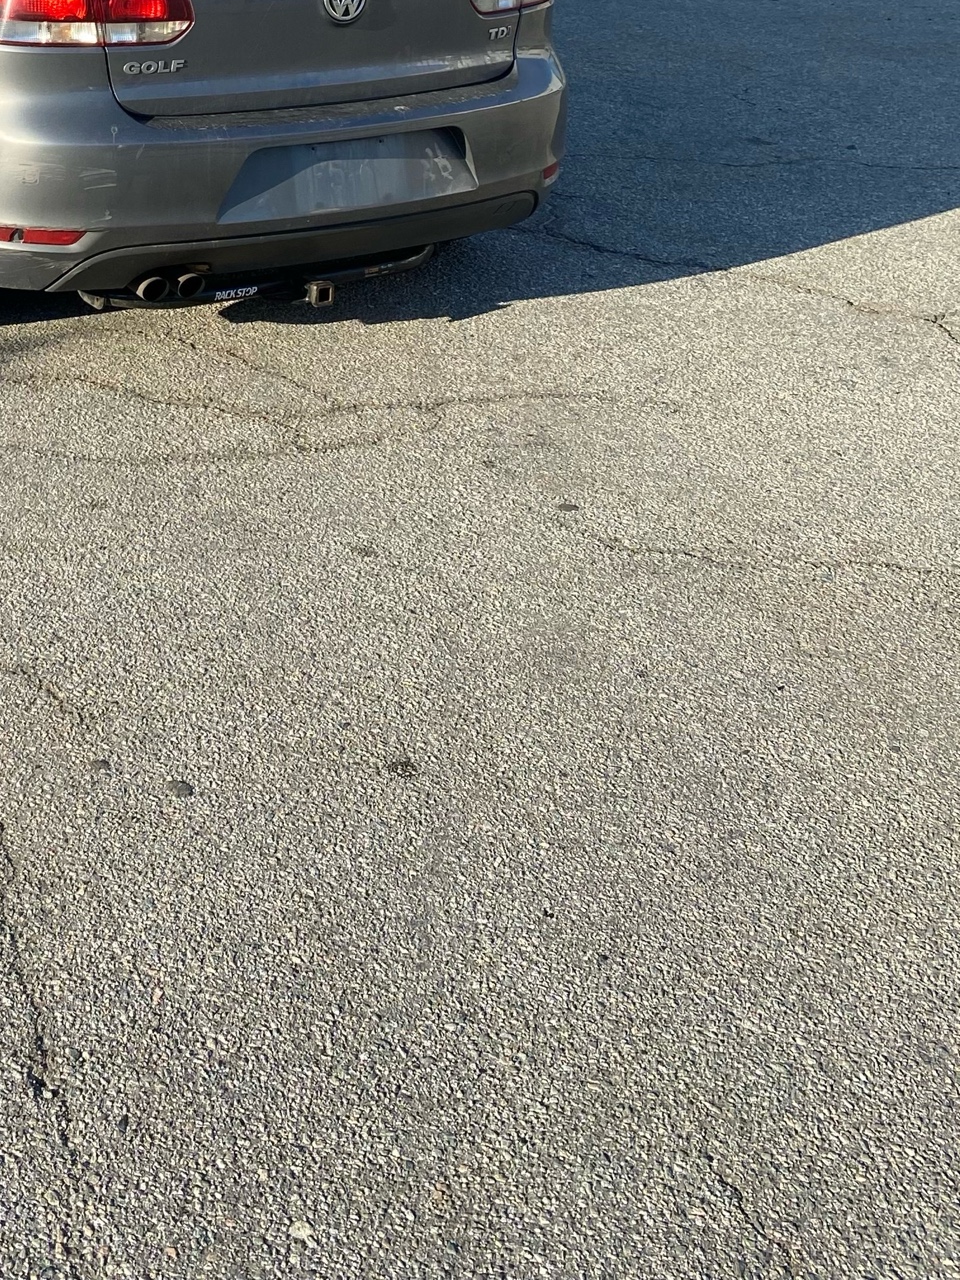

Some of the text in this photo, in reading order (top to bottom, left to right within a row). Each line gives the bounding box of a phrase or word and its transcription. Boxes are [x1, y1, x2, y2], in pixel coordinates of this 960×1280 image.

[489, 25, 511, 40] TDI
[123, 59, 185, 75] GOLF
[214, 286, 258, 301] RACK STOP
